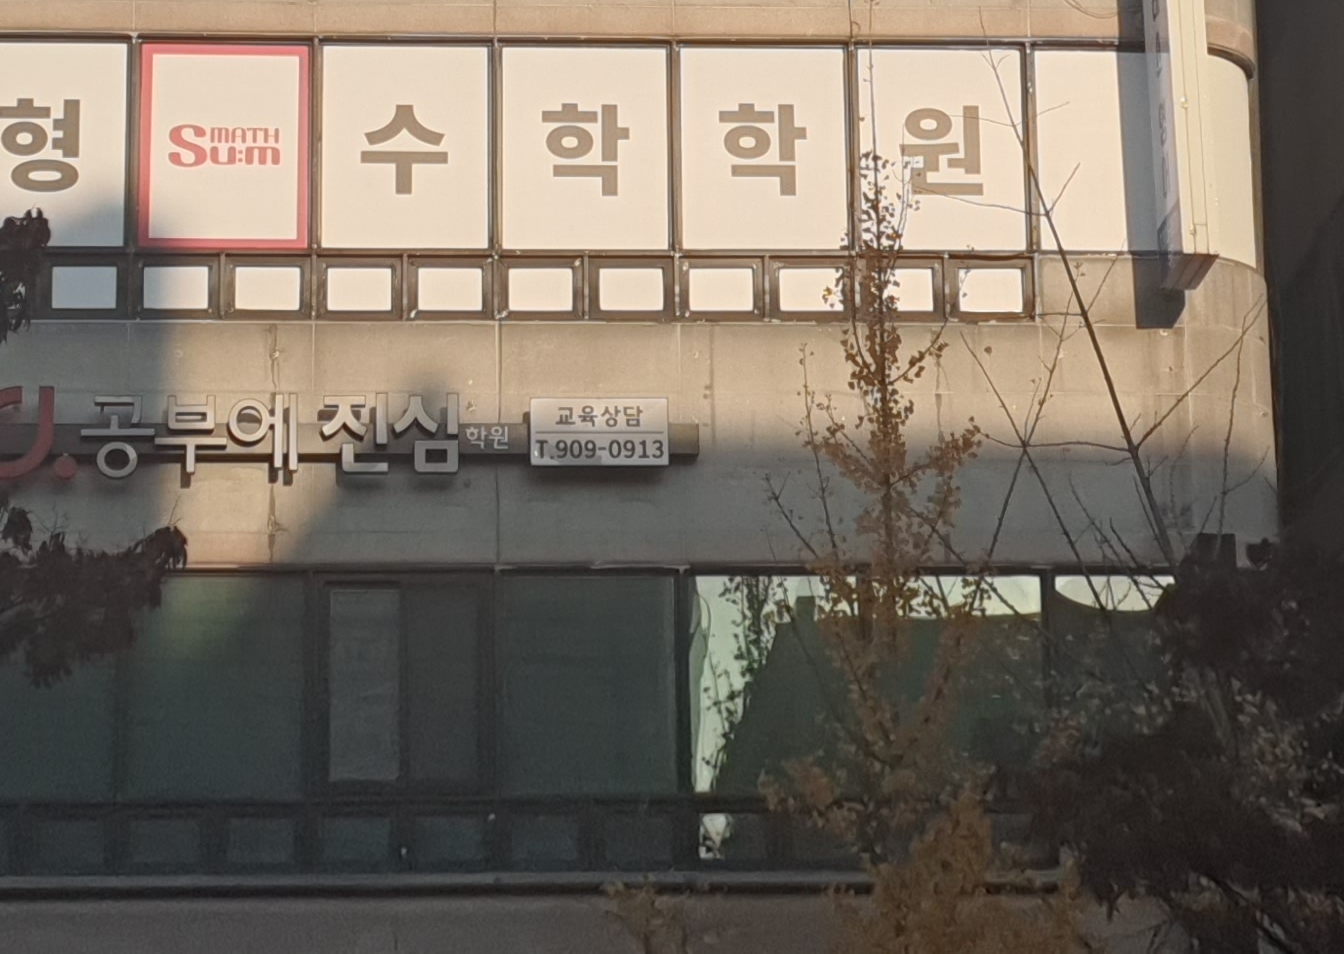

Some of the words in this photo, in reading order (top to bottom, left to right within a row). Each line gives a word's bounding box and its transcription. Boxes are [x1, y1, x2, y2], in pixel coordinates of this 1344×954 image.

[210, 126, 281, 144] MATH
[554, 405, 645, 428] 교육상담
[79, 392, 300, 479] 공부에
[319, 392, 460, 474] 진심
[464, 425, 510, 450] 학원
[535, 438, 666, 461] T.909-0913
